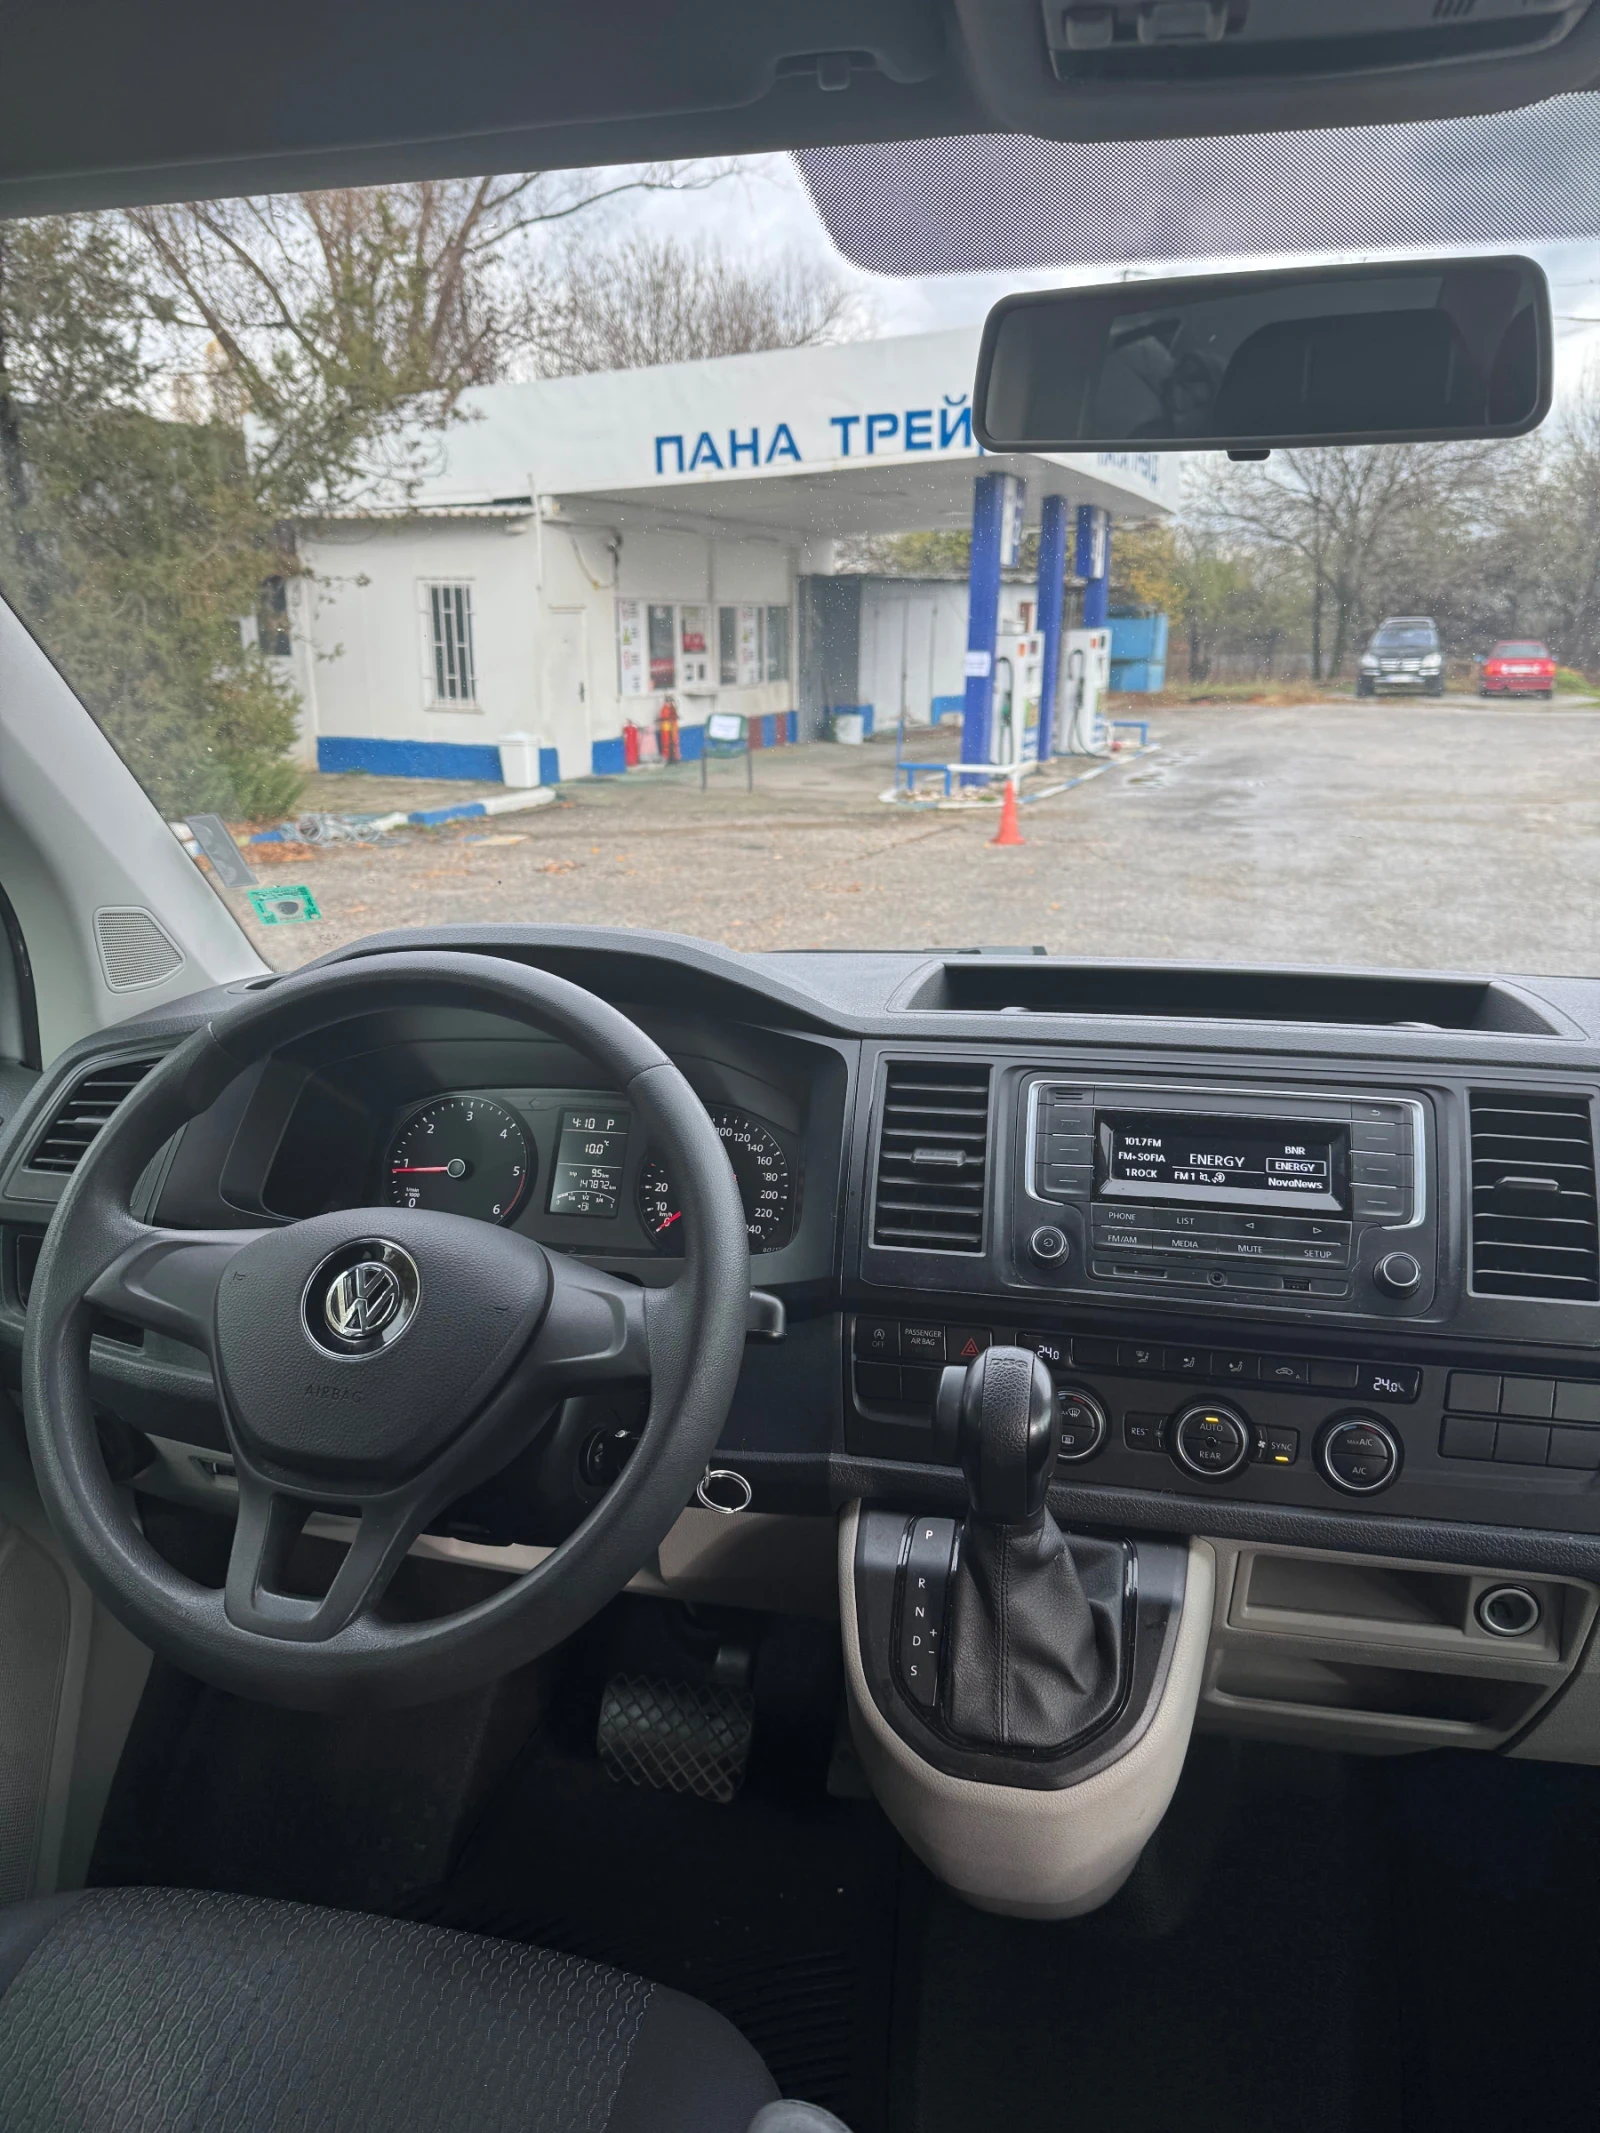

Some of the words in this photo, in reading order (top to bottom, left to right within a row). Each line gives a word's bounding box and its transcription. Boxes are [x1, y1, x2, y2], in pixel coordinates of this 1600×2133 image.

[655, 423, 802, 474] ПАНА
[831, 395, 984, 456] ТРЕЙ
[466, 1111, 474, 1121] 3
[427, 1124, 435, 1134] 2
[572, 1118, 596, 1129] 4:10
[606, 1119, 615, 1130] P
[500, 1129, 508, 1139] 4
[734, 1133, 751, 1143] 120
[747, 1144, 764, 1152] 140
[1284, 1145, 1306, 1155] BNR
[757, 1156, 773, 1166] 160
[1118, 1151, 1166, 1163] FM+SOFIA
[1189, 1153, 1245, 1168] ENERGY
[403, 1158, 409, 1168] 1
[1275, 1161, 1315, 1172] ENERGY
[512, 1166, 520, 1176] 5
[1174, 1171, 1189, 1180] FM
[762, 1172, 778, 1182] 180
[654, 1183, 668, 1192] 20
[1268, 1177, 1323, 1189] NovaNews
[760, 1190, 779, 1200] 200
[408, 1197, 416, 1208] 0
[656, 1201, 667, 1211] 10
[492, 1204, 500, 1215] 6
[754, 1208, 773, 1218] 220
[1108, 1211, 1136, 1221] PHONE
[1176, 1217, 1195, 1226] LIST
[1107, 1234, 1138, 1244] FM/AM
[1171, 1239, 1199, 1249] MEDIA
[1237, 1244, 1264, 1254] MUTE
[1303, 1249, 1332, 1259] SETUP
[904, 1328, 943, 1338] PASSENGER
[872, 1339, 885, 1348] OFF
[1037, 1344, 1060, 1361] 24.0
[1373, 1377, 1398, 1394] 24.0
[303, 1383, 362, 1404] AIRBAG
[1199, 1423, 1224, 1433] AUTO
[1271, 1441, 1293, 1451] SYNC
[1199, 1450, 1221, 1461] REAR
[1352, 1465, 1366, 1476] A/C
[925, 1529, 933, 1540] P
[918, 1578, 926, 1589] R
[915, 1606, 925, 1618] N
[912, 1635, 921, 1646] D
[910, 1665, 917, 1677] S
